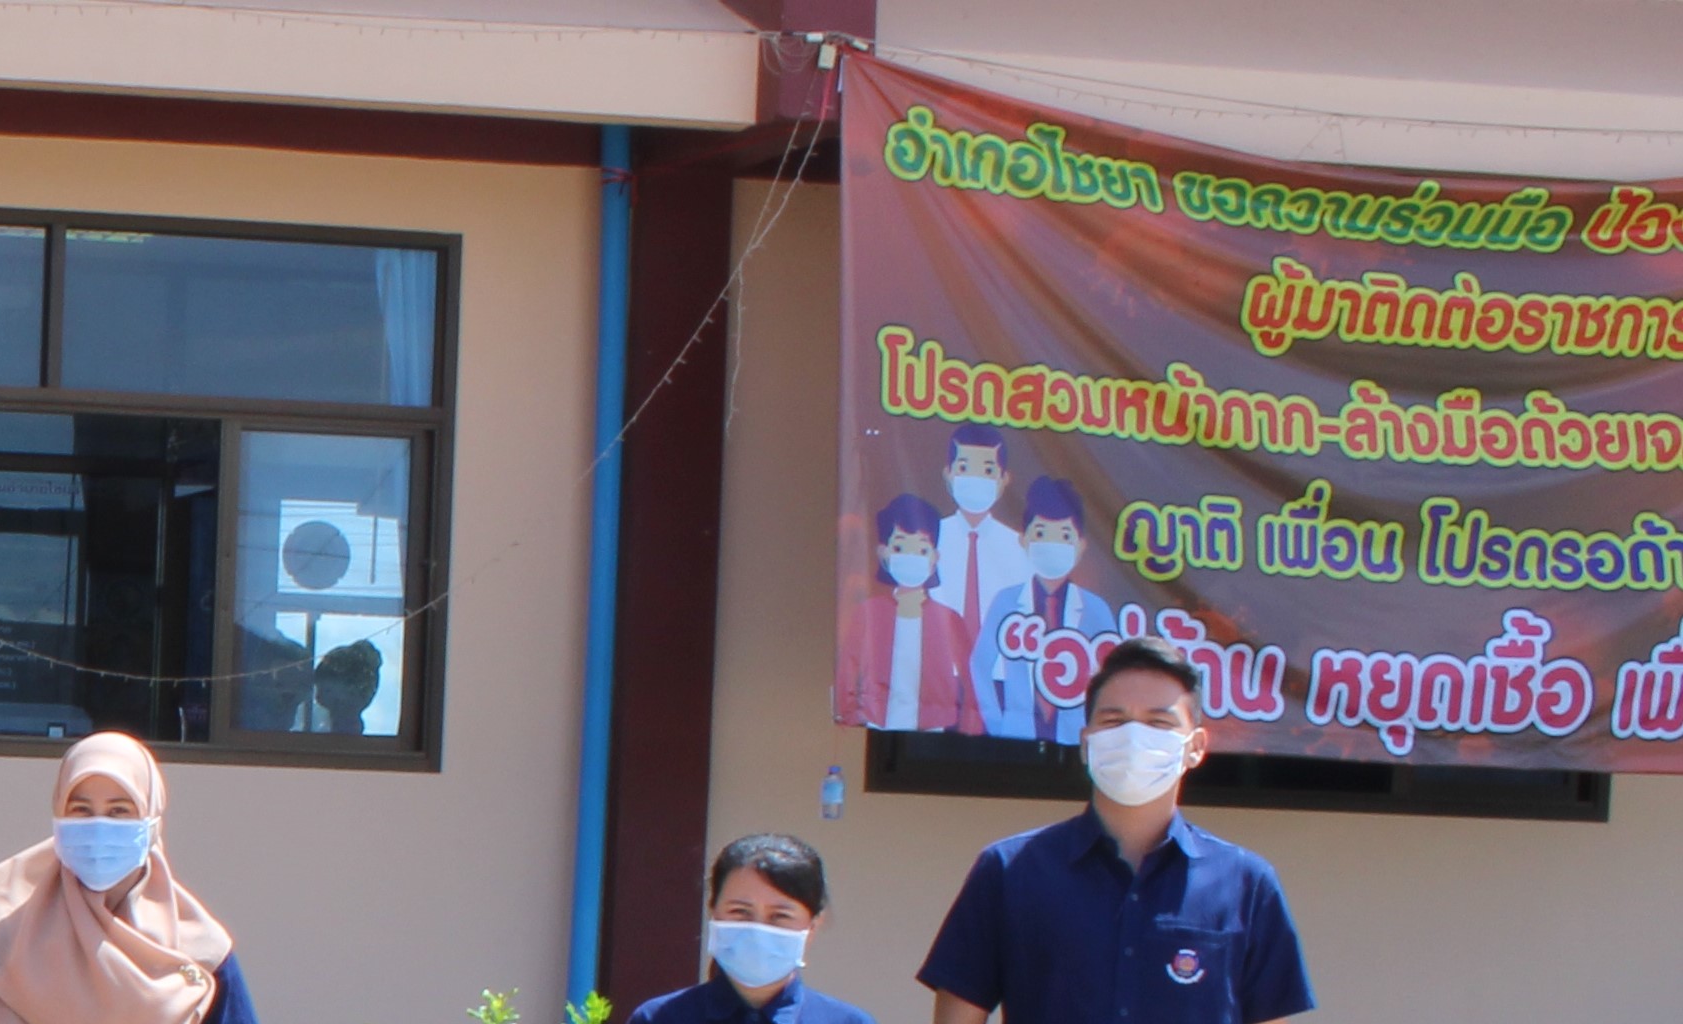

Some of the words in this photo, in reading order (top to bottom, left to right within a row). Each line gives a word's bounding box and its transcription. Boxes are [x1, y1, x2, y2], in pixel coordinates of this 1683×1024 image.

[885, 106, 1164, 213] อำเภอไชยา
[1173, 171, 1573, 253] ขอความร่วมมือ
[1114, 495, 1243, 580] ญาติ
[1259, 479, 1404, 582] เพื่อน
[1306, 608, 1594, 755] หยุดเชื้อ
